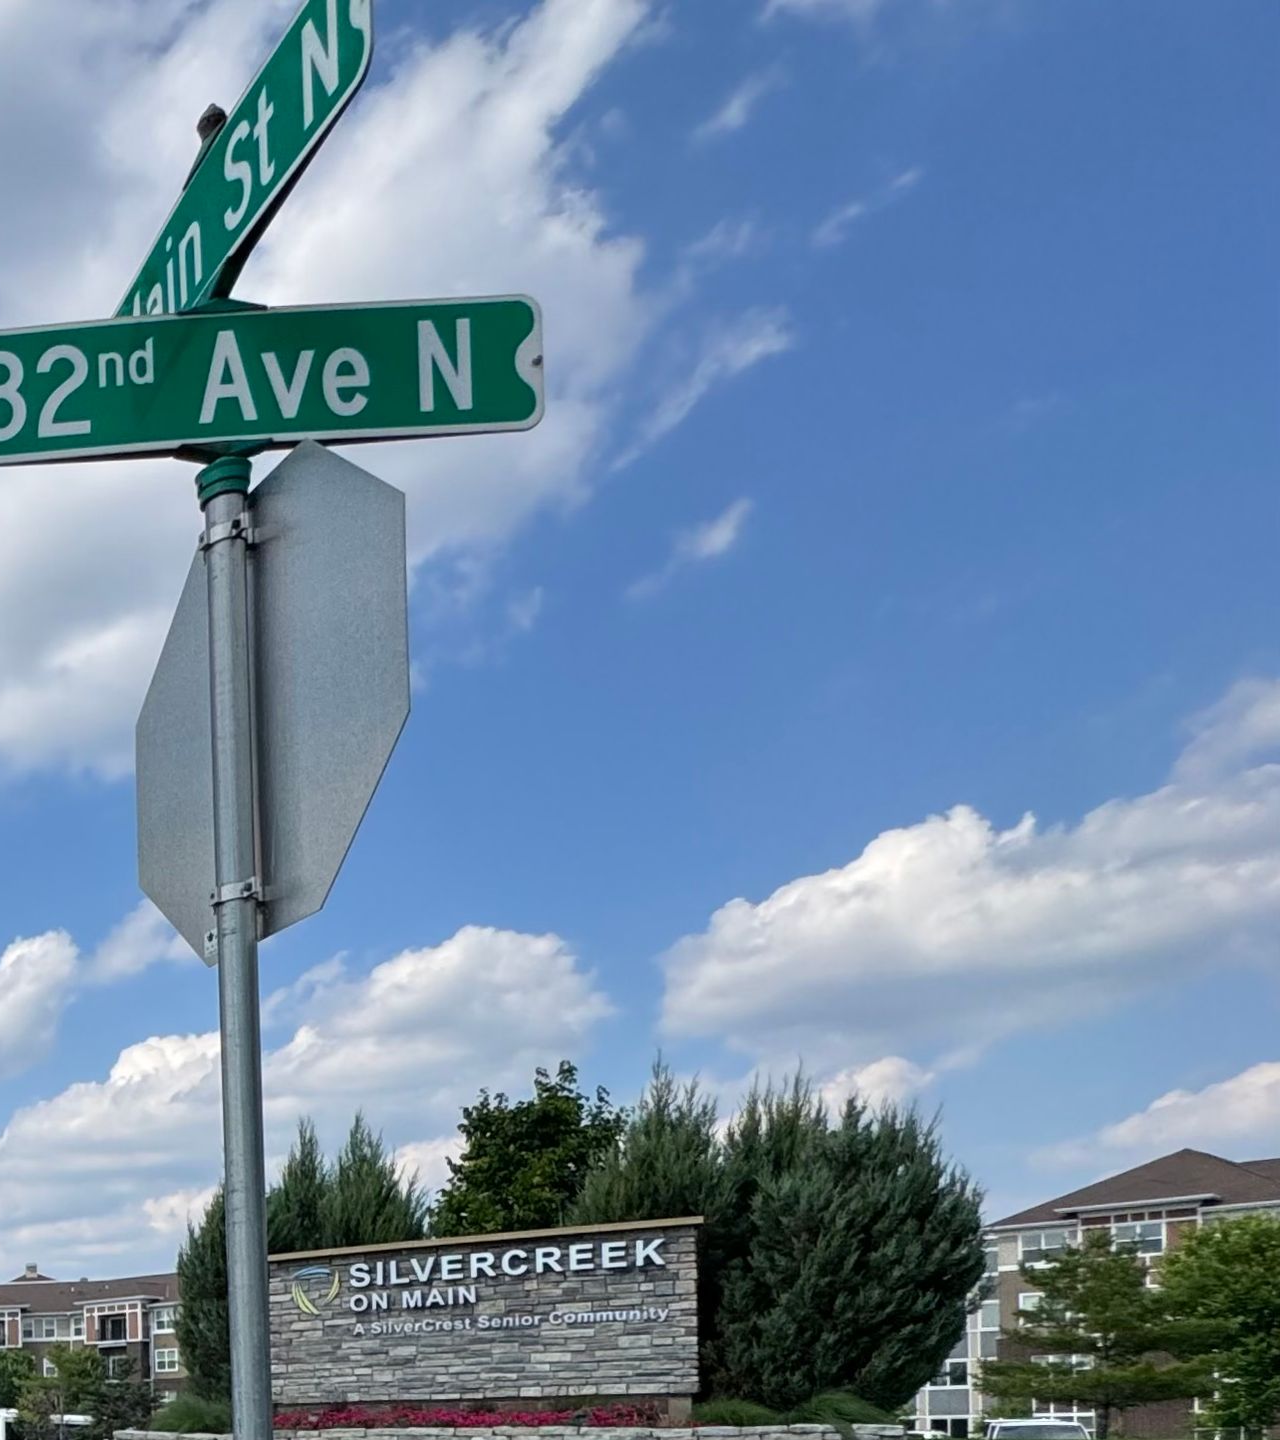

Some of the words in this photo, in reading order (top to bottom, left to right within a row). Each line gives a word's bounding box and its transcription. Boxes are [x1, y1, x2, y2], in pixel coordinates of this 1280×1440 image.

[132, 221, 202, 316] ain
[224, 86, 275, 230] St
[301, 0, 339, 130] N
[198, 329, 371, 425] Ave
[417, 318, 473, 412] N
[348, 1238, 667, 1288] SILVERCREEK
[349, 1293, 388, 1312] ON
[401, 1286, 477, 1309] MAIN
[352, 1323, 366, 1336] A
[370, 1319, 472, 1336] SilverCrest
[477, 1313, 541, 1329] Senior
[548, 1305, 670, 1327] Community
